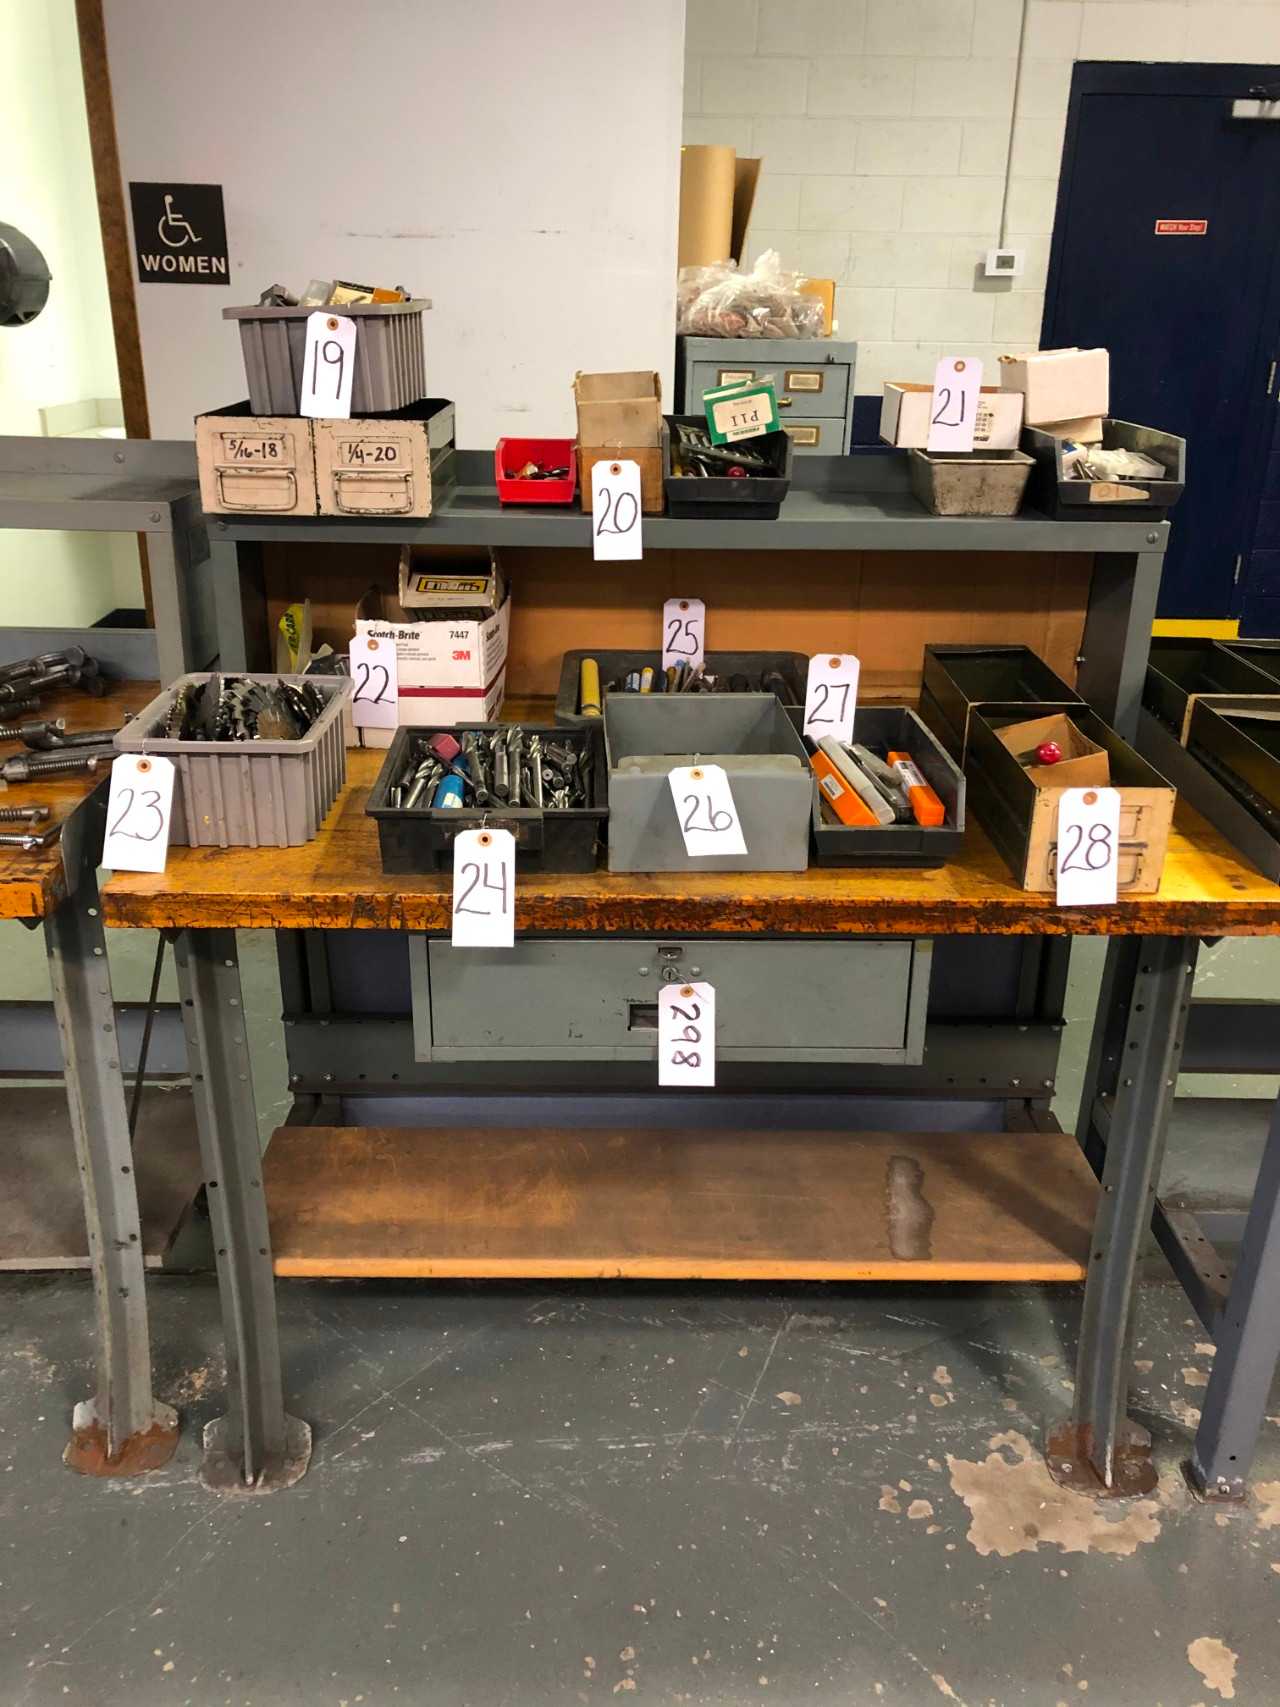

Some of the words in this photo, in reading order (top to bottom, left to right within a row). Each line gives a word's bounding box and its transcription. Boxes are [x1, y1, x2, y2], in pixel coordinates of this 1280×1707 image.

[141, 253, 226, 275] WOMEN
[311, 340, 344, 400] 19
[932, 387, 965, 427] 21
[228, 439, 278, 459] 5/16-18
[348, 442, 397, 464] 1/4-20
[596, 487, 638, 536] 20
[449, 630, 469, 639] 7447
[667, 619, 699, 655] 25
[452, 650, 471, 661] 3M
[353, 663, 395, 704] 22
[807, 684, 850, 725] 27
[109, 788, 164, 842] 23
[683, 795, 733, 833] 26
[1060, 823, 1111, 874] 28
[455, 861, 507, 916] 24
[670, 1003, 702, 1068] 298
